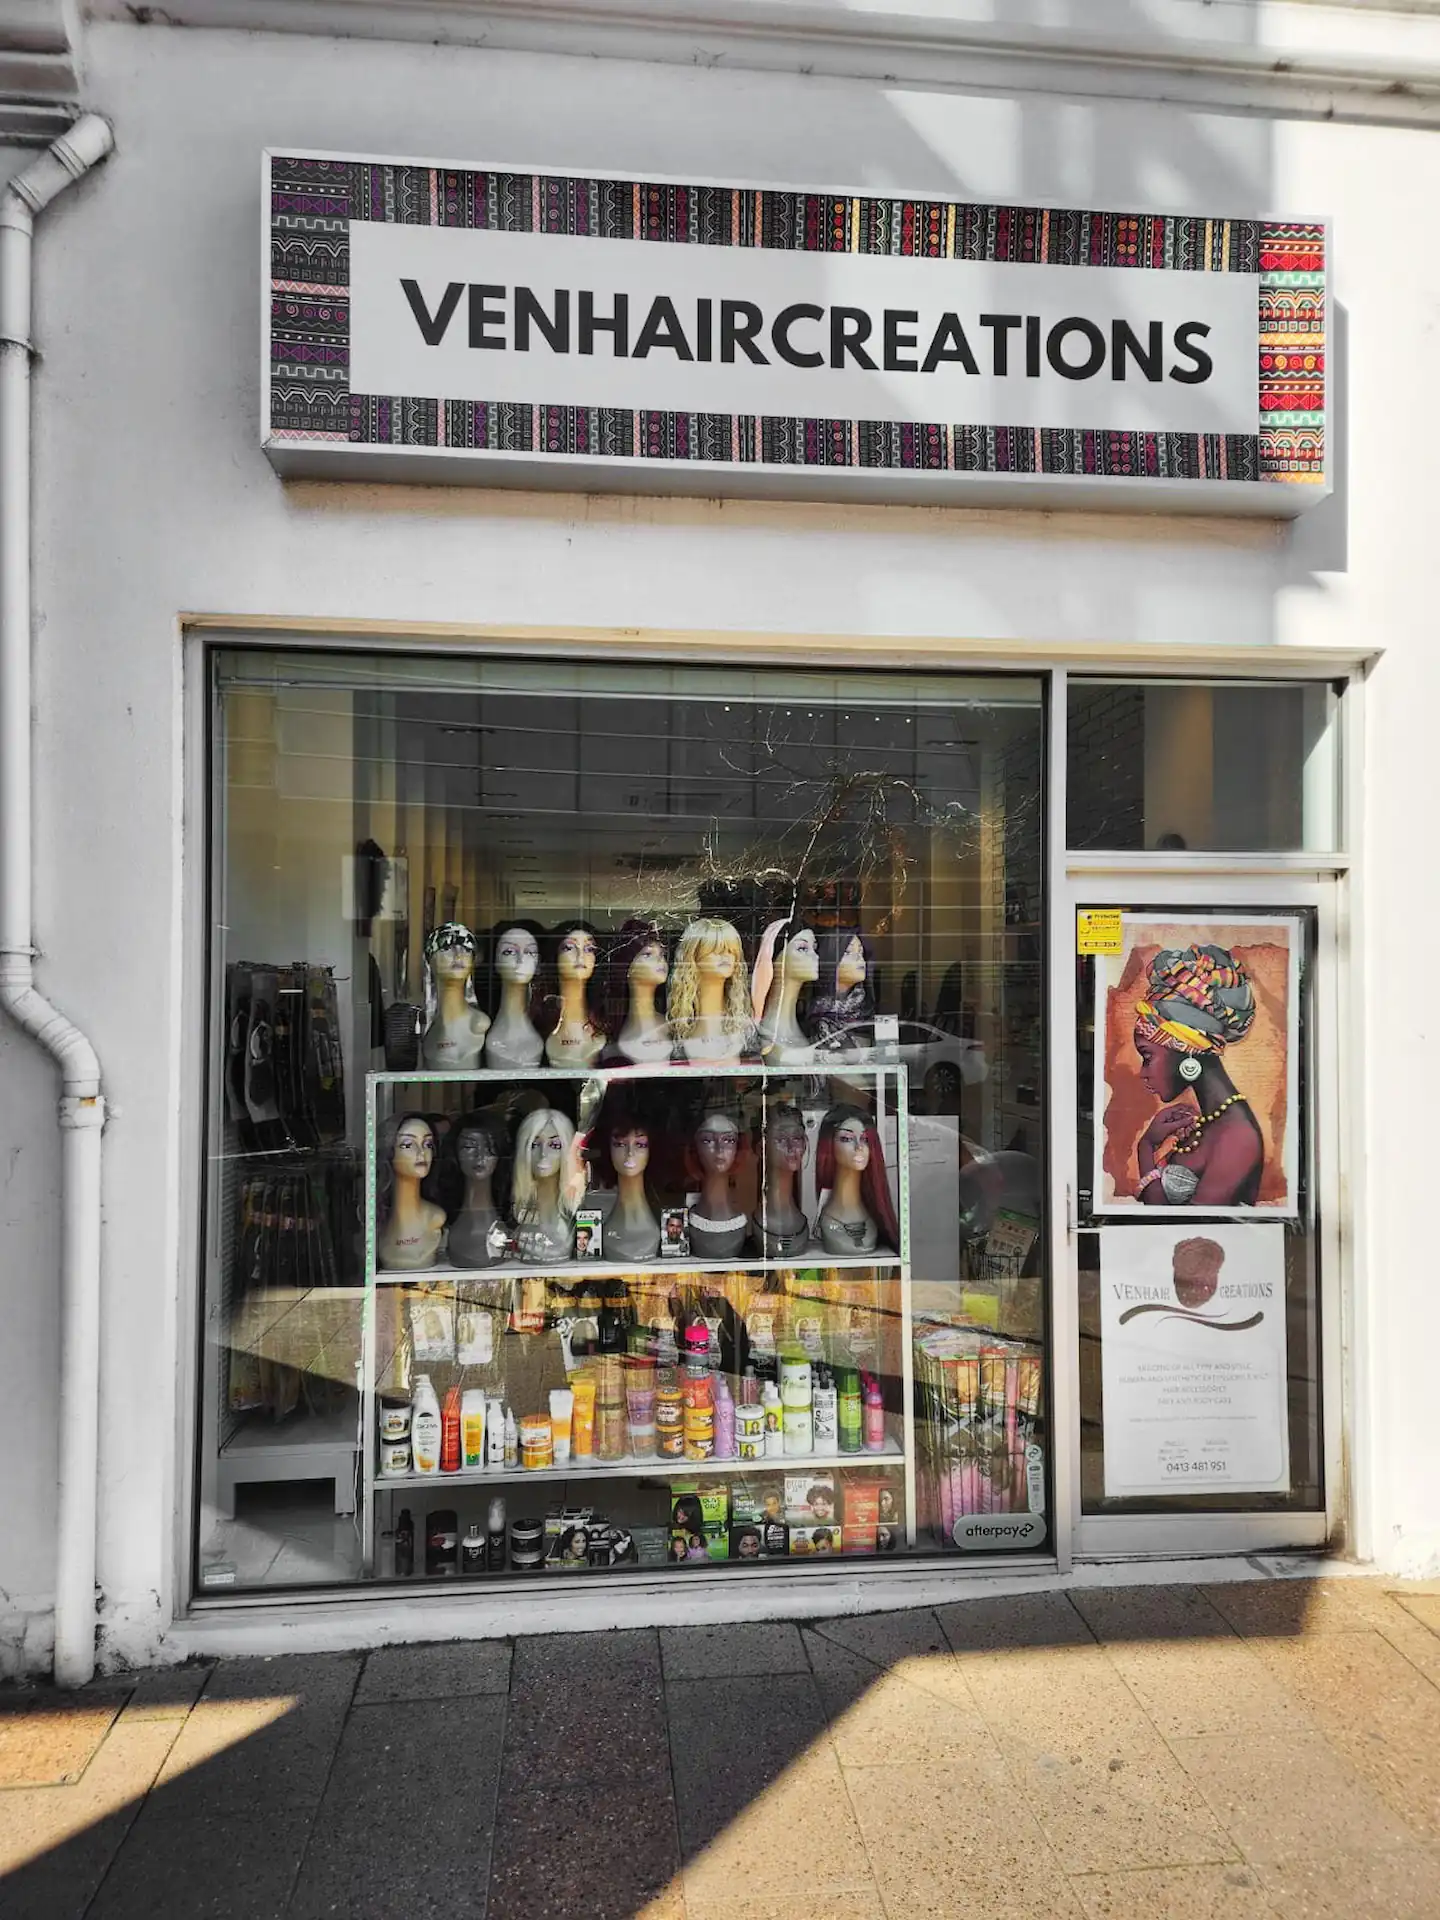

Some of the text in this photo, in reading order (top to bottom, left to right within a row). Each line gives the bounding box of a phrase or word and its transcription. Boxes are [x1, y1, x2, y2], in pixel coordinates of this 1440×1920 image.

[400, 278, 1214, 386] VENHAIRCREATIONS
[1166, 1460, 1226, 1472] 0413 481 951
[966, 1524, 1019, 1538] afterpay
